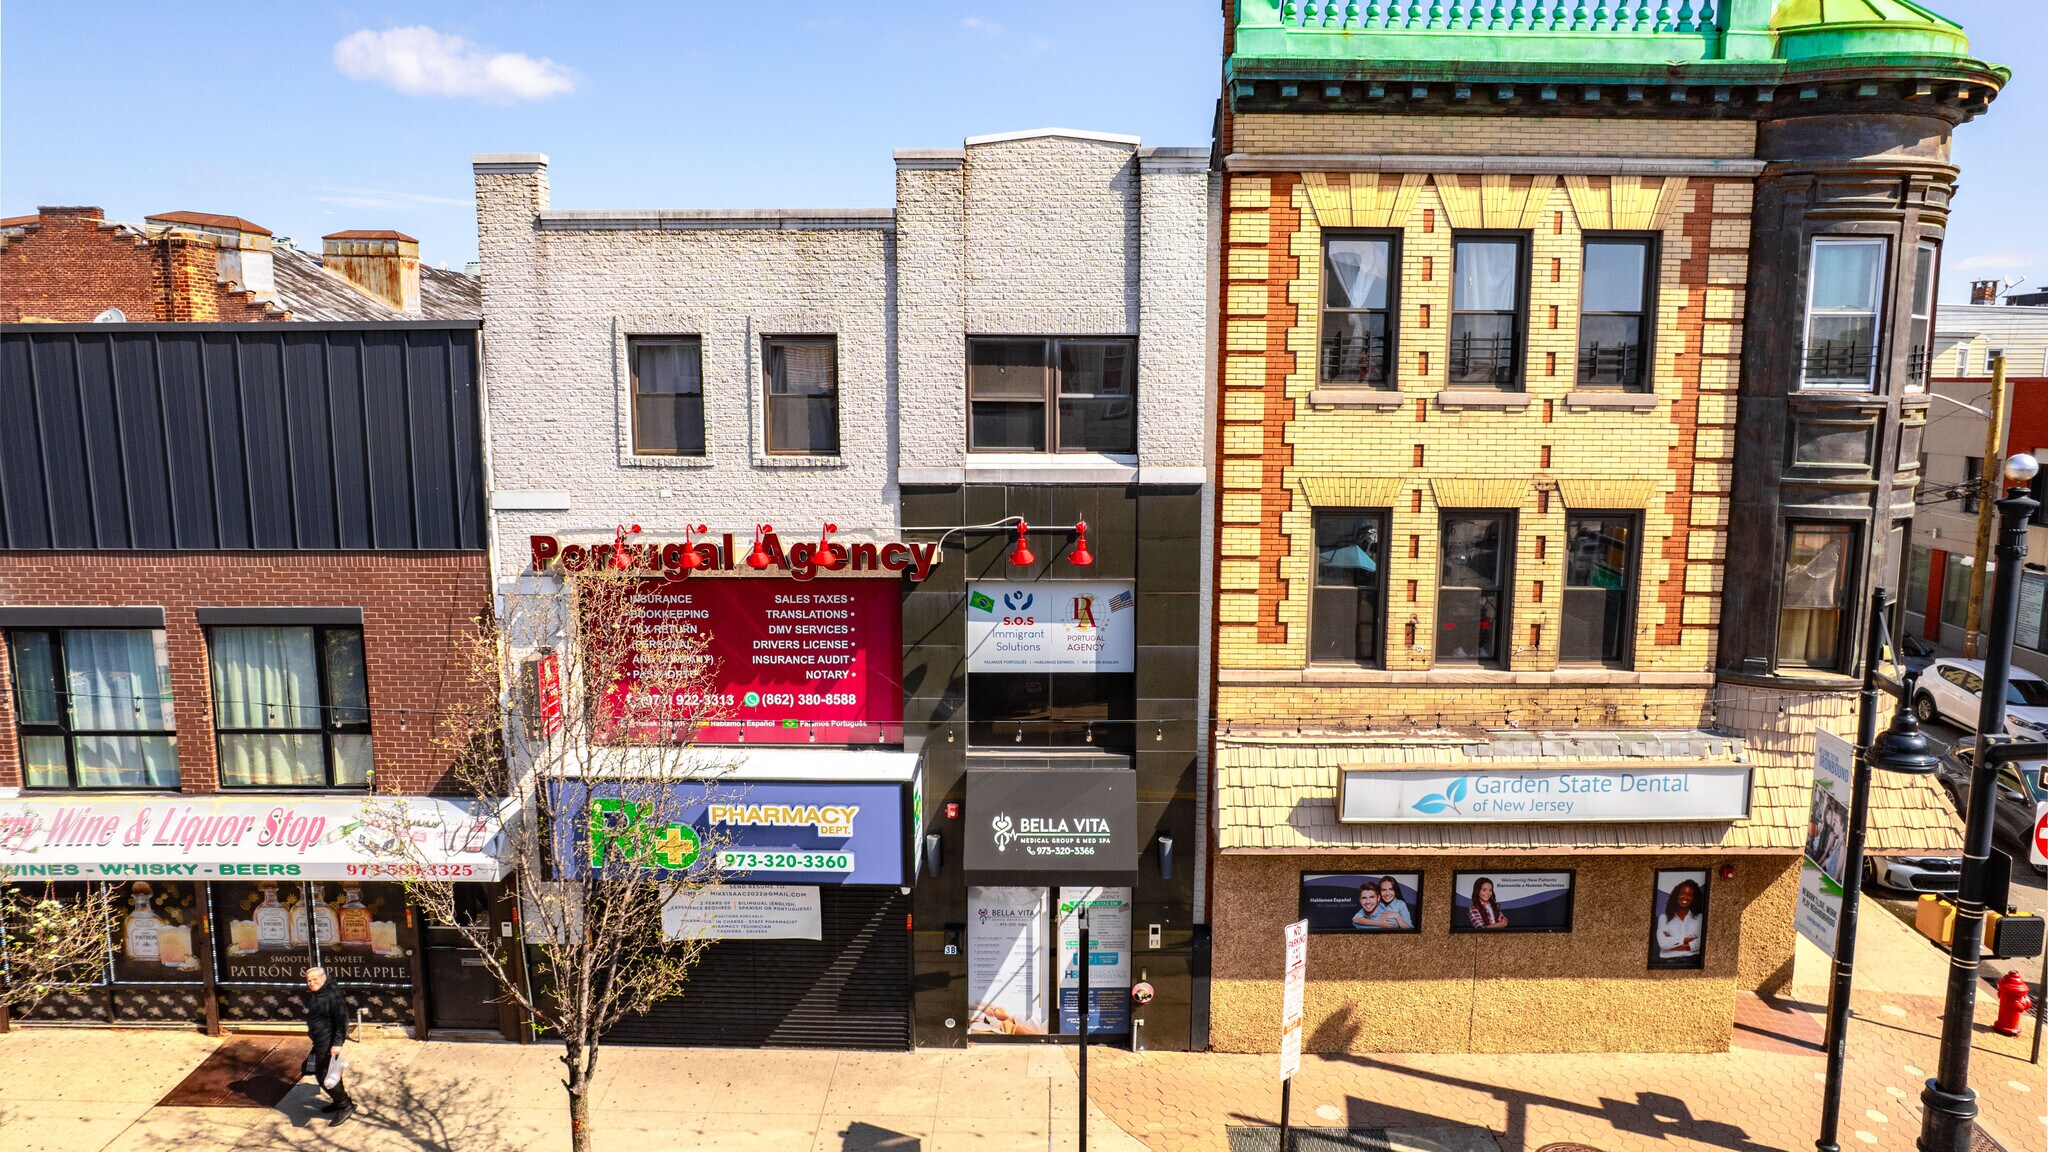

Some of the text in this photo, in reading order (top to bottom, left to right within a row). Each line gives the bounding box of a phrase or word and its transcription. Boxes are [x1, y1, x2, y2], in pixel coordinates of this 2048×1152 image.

[752, 533, 938, 582] Agency
[630, 594, 692, 604] INSURANCE
[774, 594, 848, 604] SALES TAXES
[630, 609, 709, 619] BOOKKEEPING
[766, 609, 848, 619] TRANSLATIONS
[1003, 616, 1035, 626] S.O.S
[632, 625, 652, 634] TAX
[768, 625, 848, 634] DMV SERVICES
[992, 629, 1045, 640] Immigrant
[753, 640, 848, 650] DRIVERS LICENSE
[996, 641, 1041, 652] Solutions
[1067, 643, 1106, 652] AGENCY
[752, 655, 850, 664] INSURANCE AUDIT
[806, 670, 849, 679] NOTARY
[762, 694, 857, 708] (862) 380-8588
[1475, 773, 1689, 795] Garden State Dental
[1473, 799, 1574, 815] of New Jersey
[711, 806, 857, 824] PHARMACY
[44, 807, 120, 847] Wine
[122, 806, 152, 847] &
[152, 806, 256, 854] Liquor
[257, 806, 326, 855] Stop
[821, 826, 850, 835] DEPT.
[1020, 818, 1110, 833] BELLA VITA
[1037, 846, 1095, 855] 973-320-3366
[725, 853, 848, 869] 973-320-3360
[99, 864, 198, 876] WHISKY
[219, 864, 301, 876] BEERS
[270, 955, 309, 963] SMOOTH
[230, 964, 292, 977] PATRÓN
[328, 966, 411, 978] PINEAPPLE.
